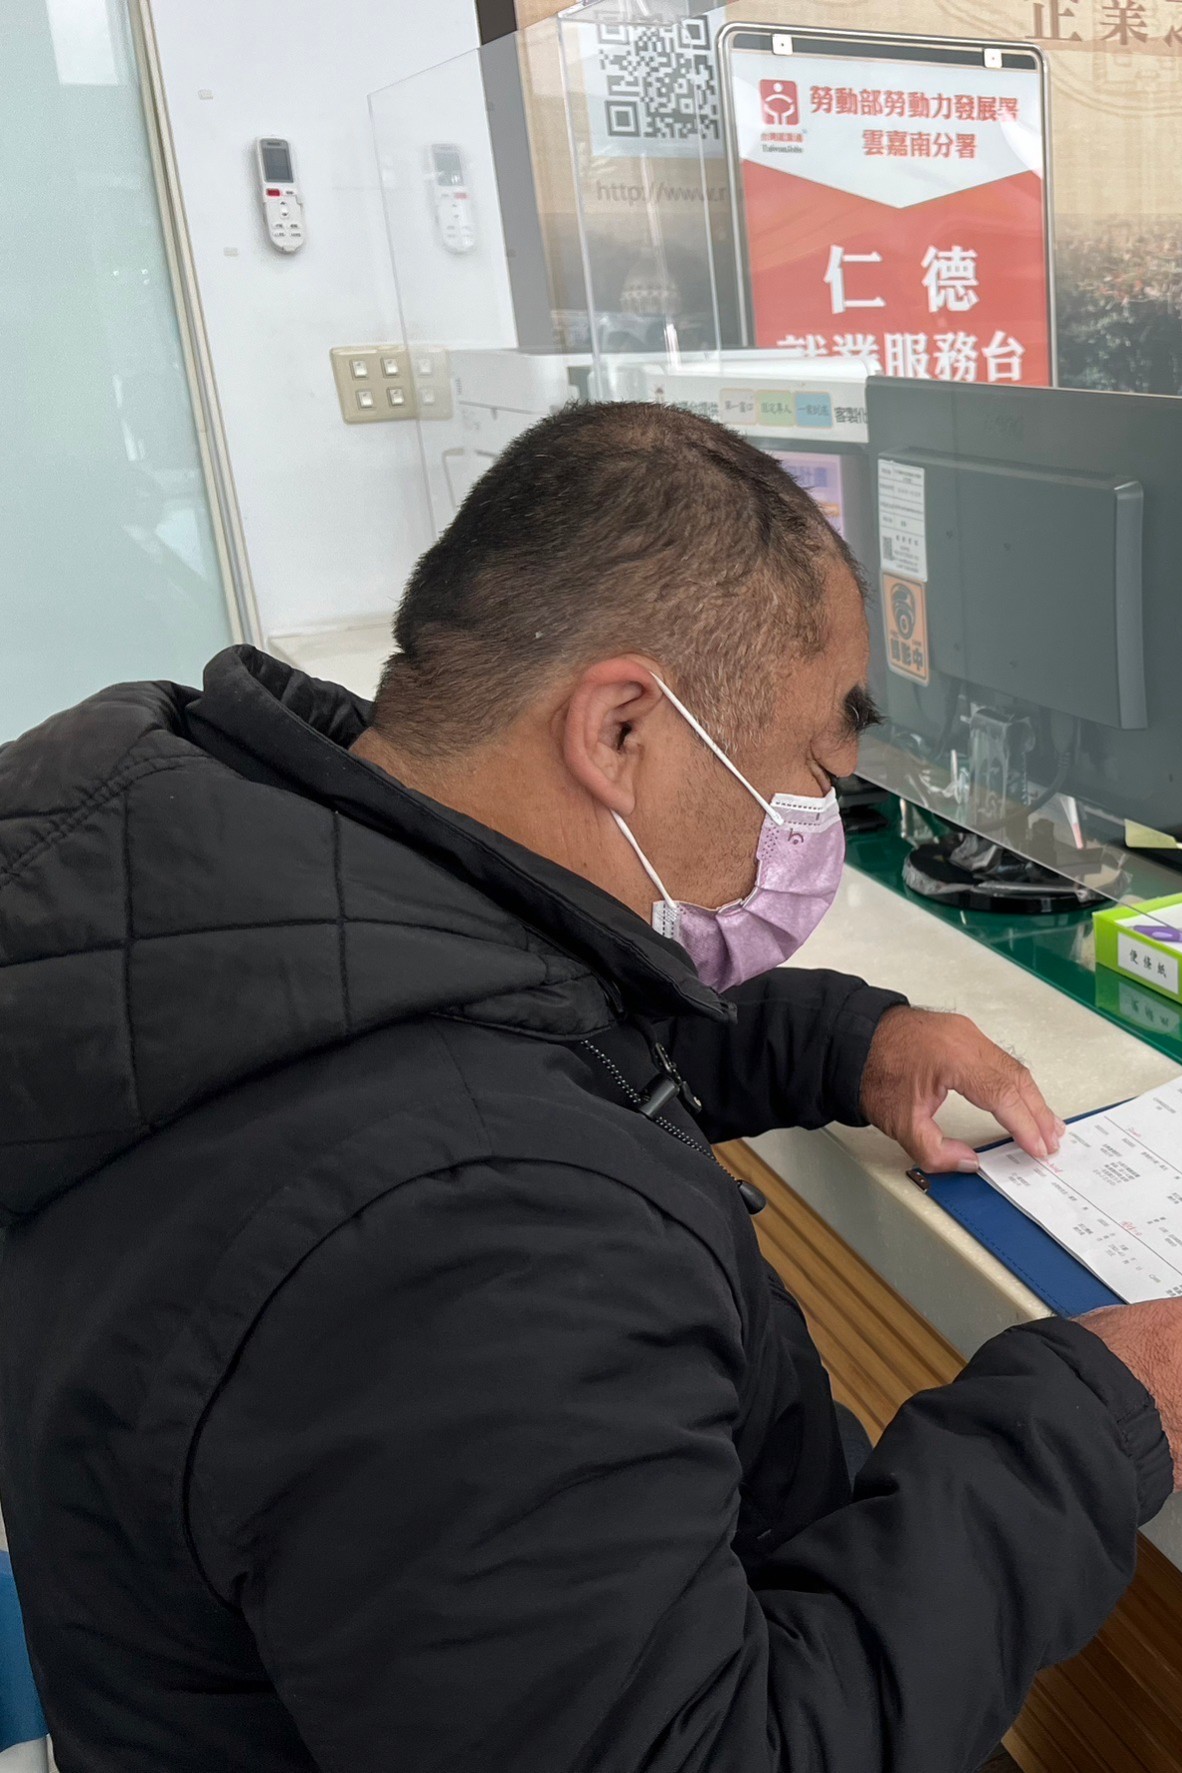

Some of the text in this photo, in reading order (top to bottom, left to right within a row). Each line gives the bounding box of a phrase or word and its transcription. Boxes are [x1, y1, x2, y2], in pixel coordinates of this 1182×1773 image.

[810, 86, 1018, 122] 勞動部勞動力發展署
[862, 130, 976, 159] 雲嘉南分署
[1129, 949, 1167, 978] 便條紙
